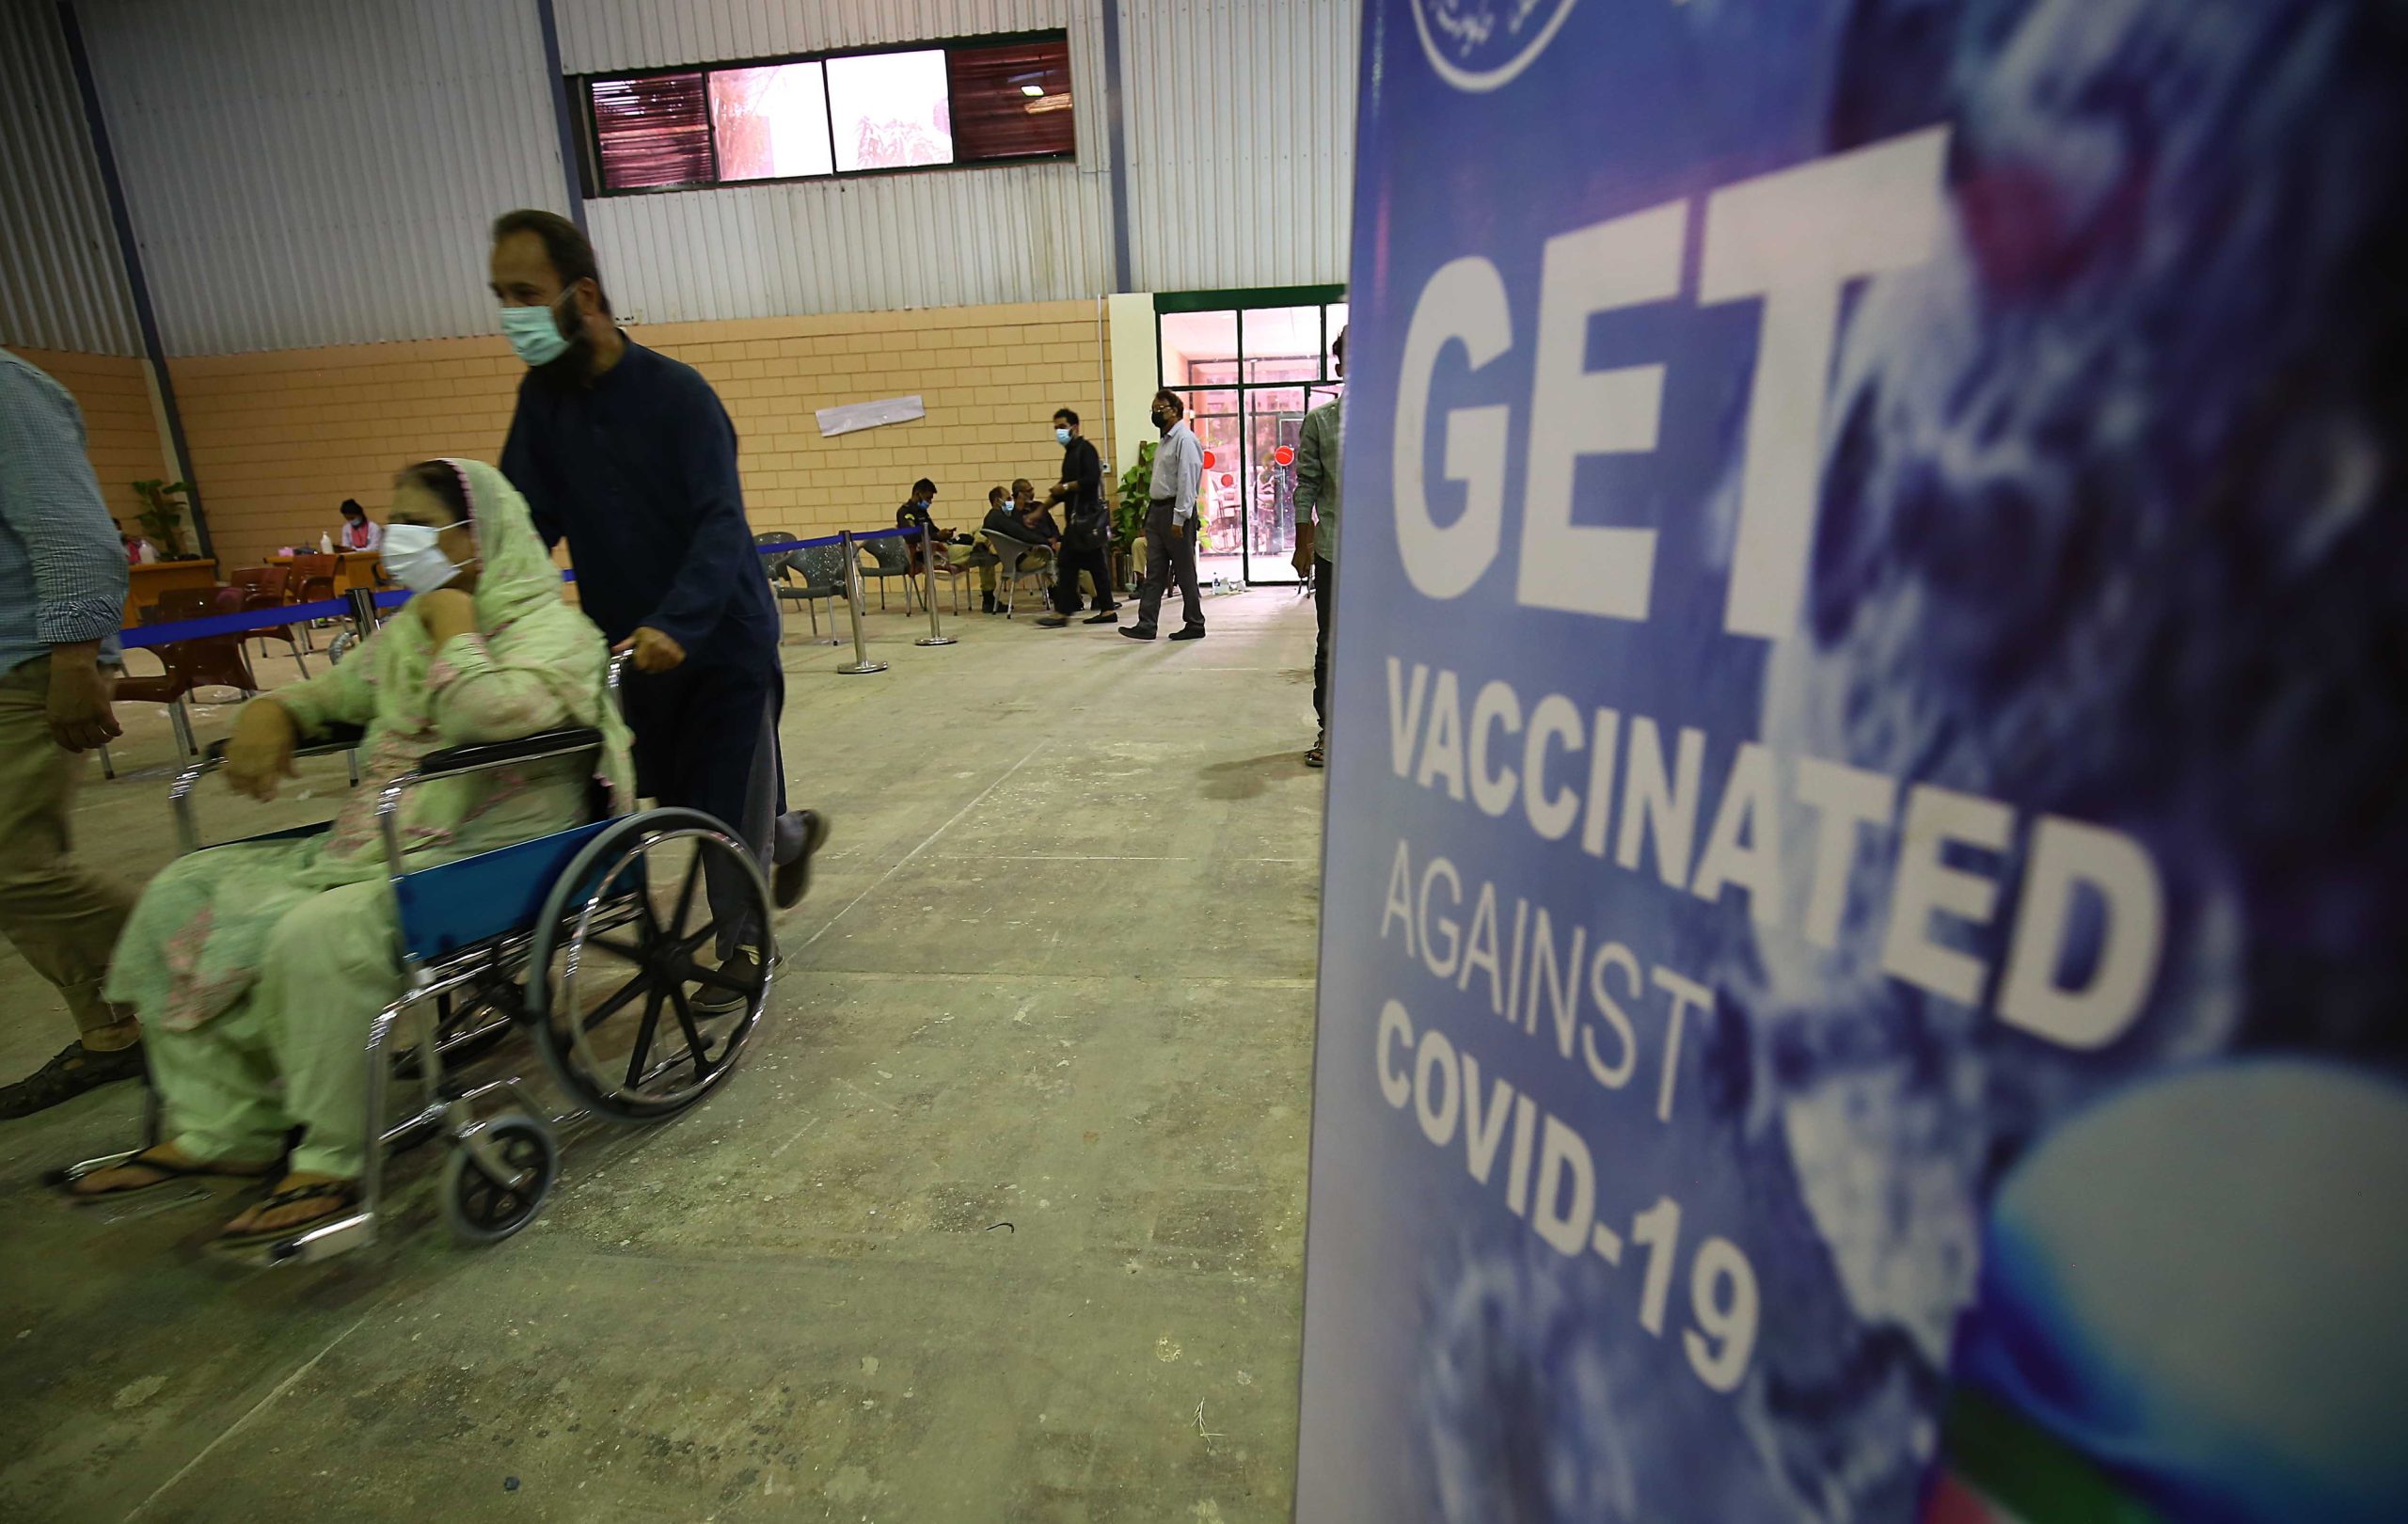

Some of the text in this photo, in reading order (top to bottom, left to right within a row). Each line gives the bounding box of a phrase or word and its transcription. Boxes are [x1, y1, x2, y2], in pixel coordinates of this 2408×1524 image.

[1394, 124, 1952, 640] GET
[1380, 839, 1716, 1120] AGAINST
[1386, 657, 2163, 1050] VACCINATED
[1377, 999, 1759, 1392] COVID-19
